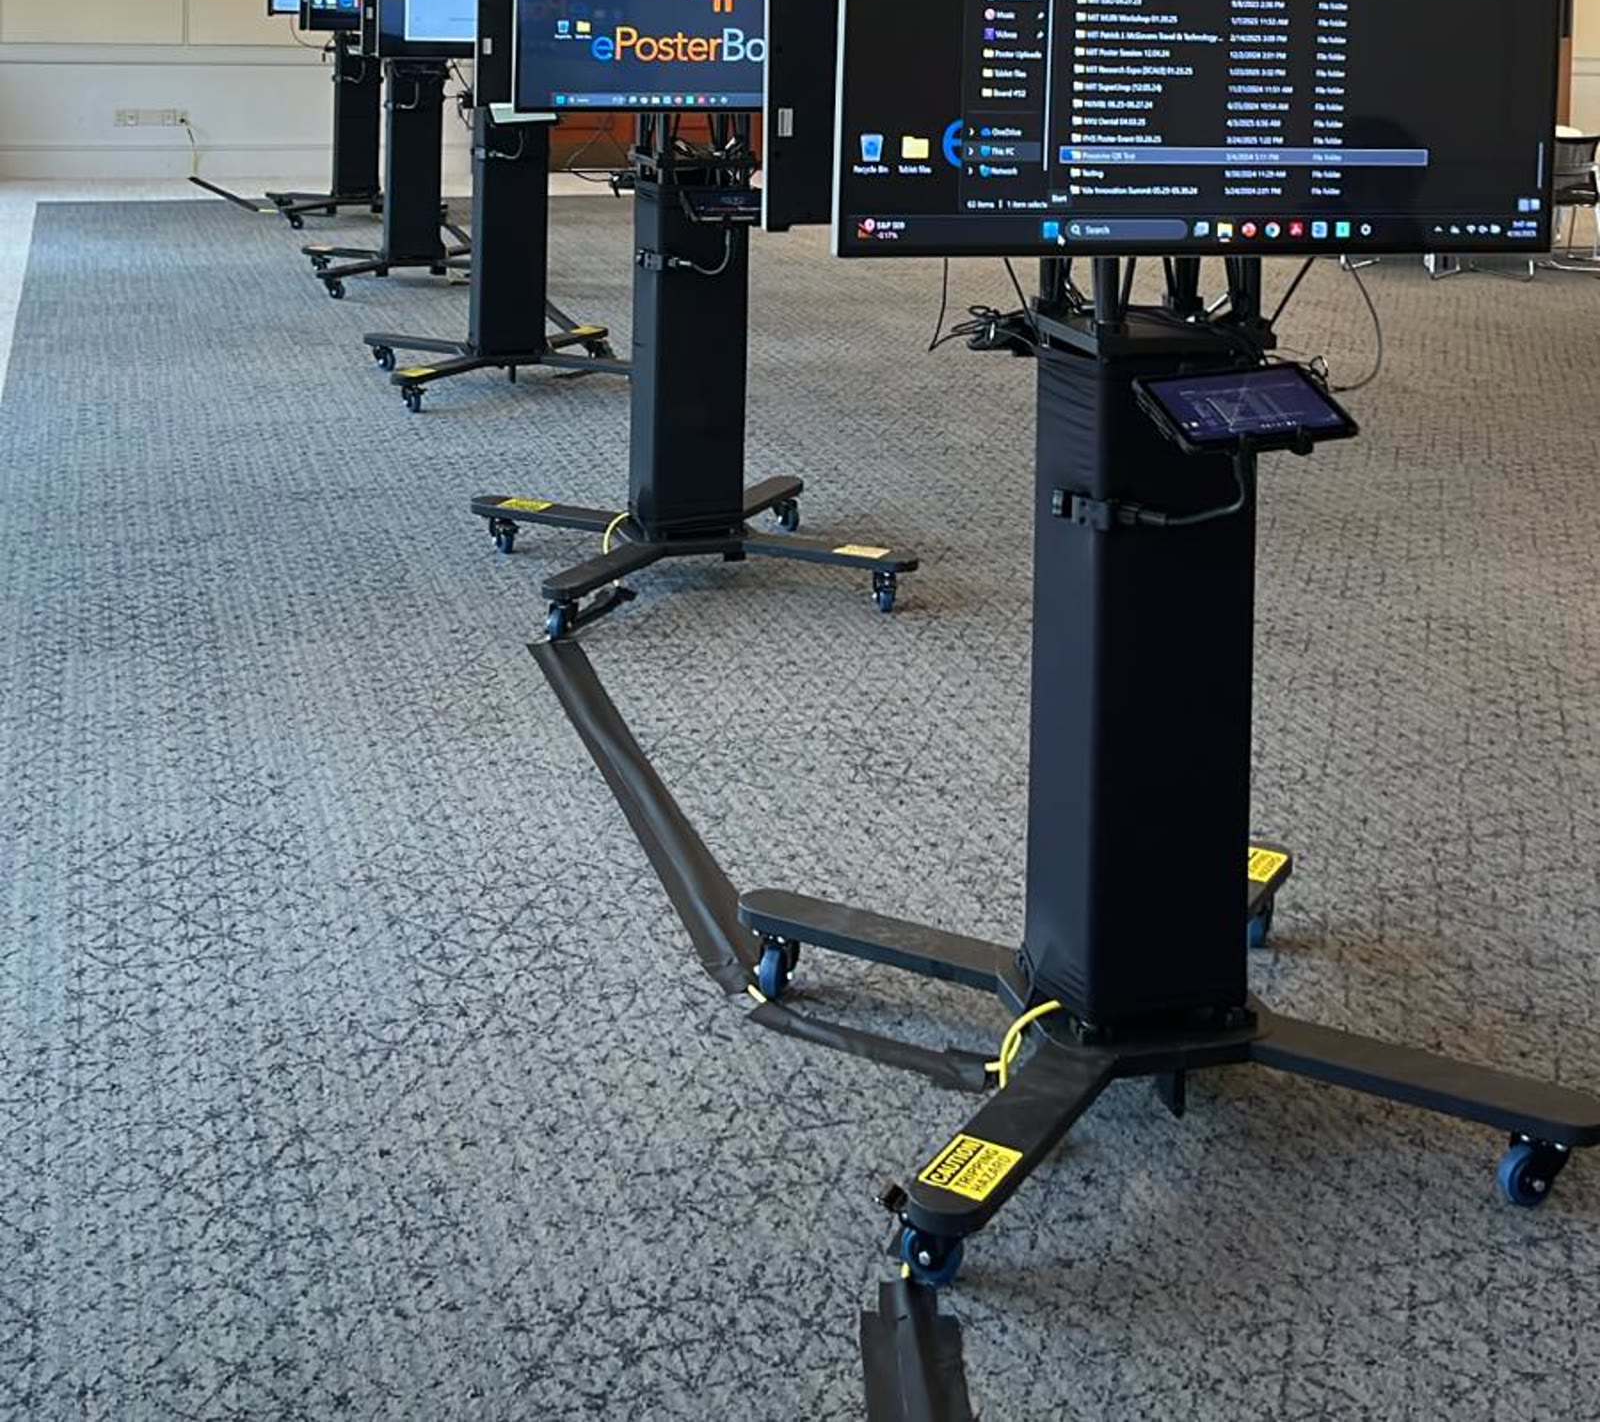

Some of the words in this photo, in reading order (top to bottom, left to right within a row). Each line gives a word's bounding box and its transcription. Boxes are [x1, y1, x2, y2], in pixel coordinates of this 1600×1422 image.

[995, 10, 1016, 21] Music
[995, 29, 1019, 40] Videos
[991, 127, 1022, 137] OneDrive
[852, 164, 878, 175] Recycle
[877, 164, 890, 174] Bin
[1085, 224, 1111, 236] Search
[929, 1139, 982, 1185] CAUTION
